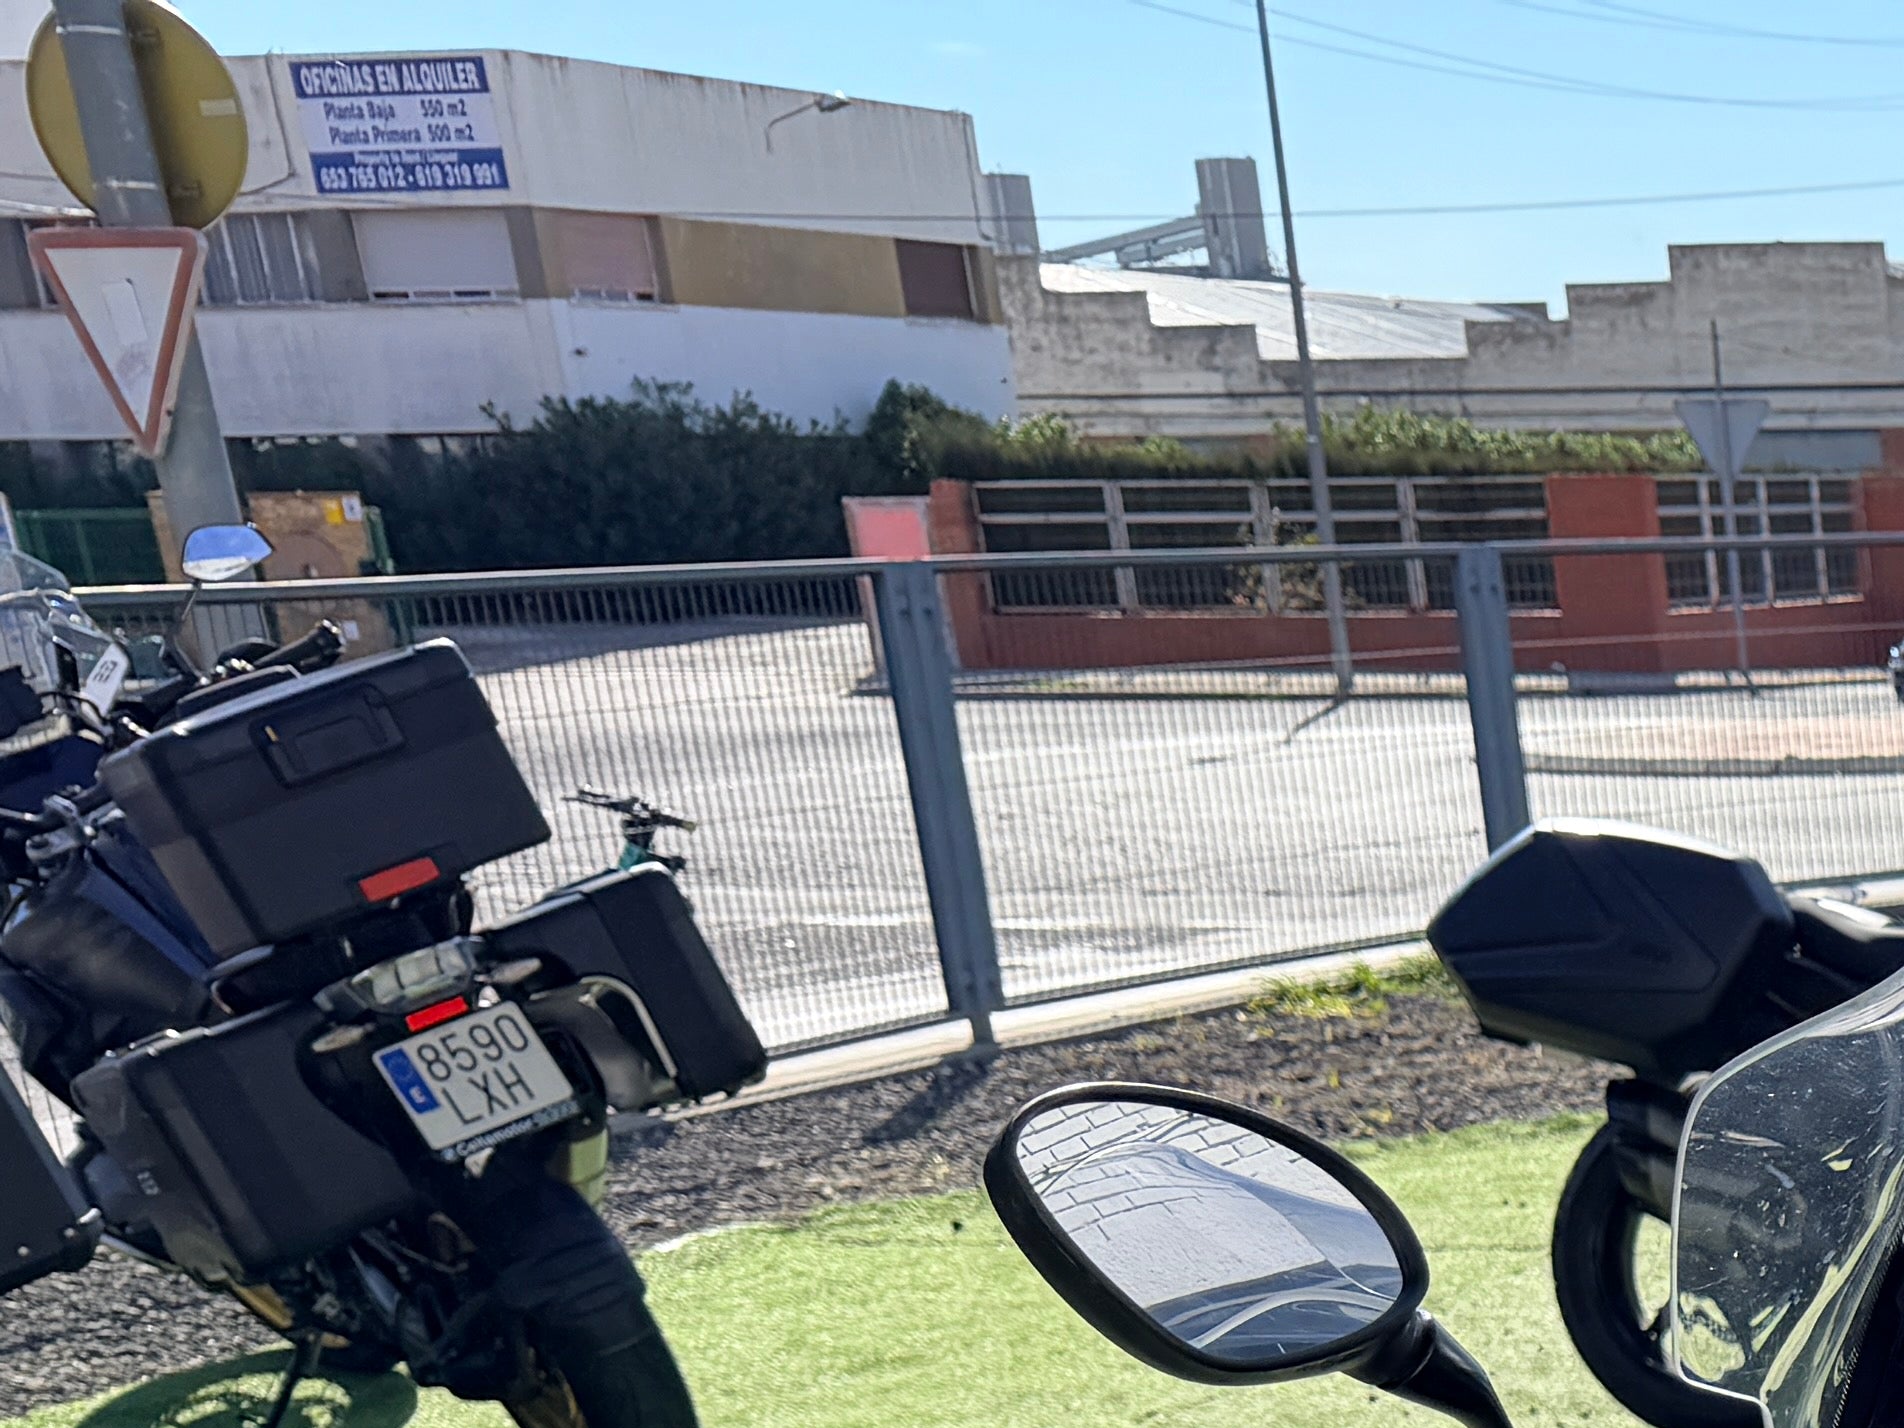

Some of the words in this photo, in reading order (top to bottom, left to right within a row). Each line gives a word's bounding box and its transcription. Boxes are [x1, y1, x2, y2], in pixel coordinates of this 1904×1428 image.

[300, 64, 375, 95] OFICINAS
[375, 64, 400, 93] EN
[402, 61, 481, 93] ALQUILER
[323, 102, 364, 121] Planta
[367, 101, 395, 121] Baja
[329, 126, 369, 145] Planta
[371, 125, 421, 144] Primera
[416, 1014, 528, 1082] 8590
[441, 1061, 535, 1126] LXH
